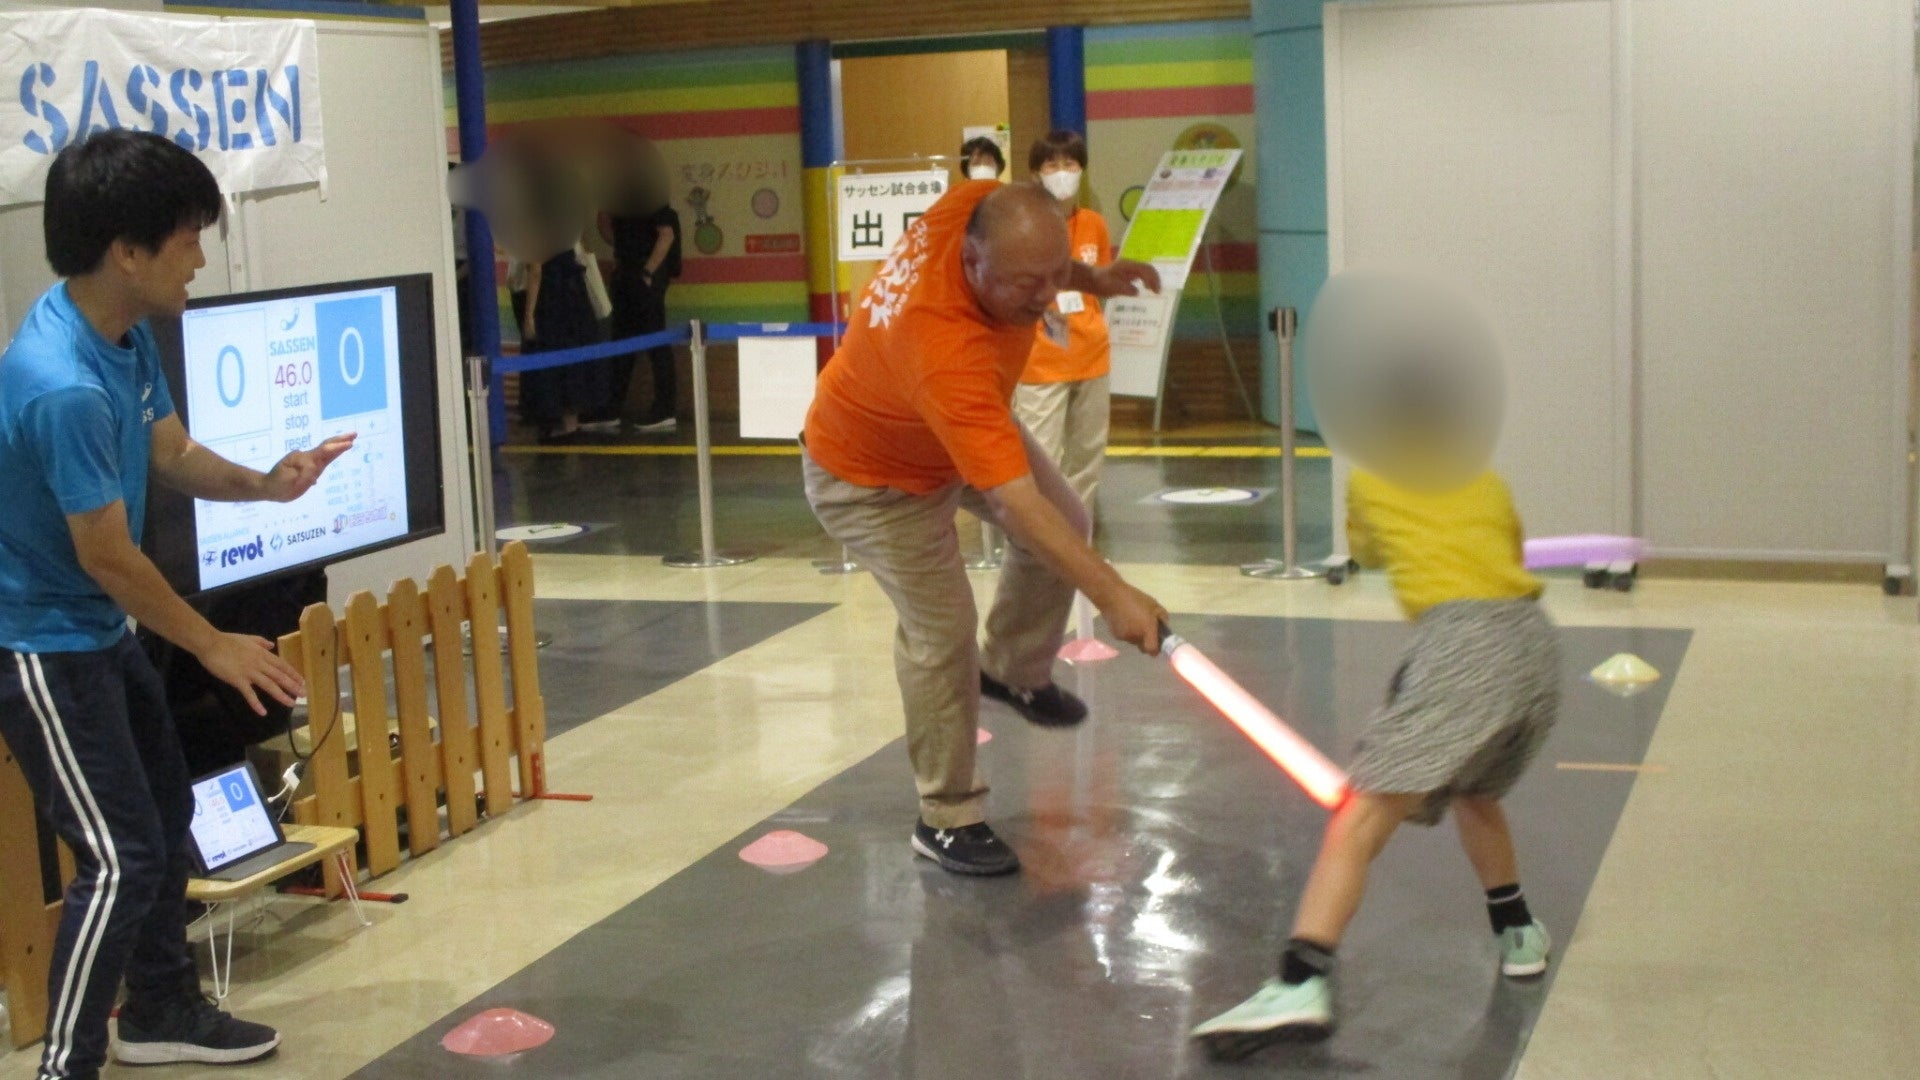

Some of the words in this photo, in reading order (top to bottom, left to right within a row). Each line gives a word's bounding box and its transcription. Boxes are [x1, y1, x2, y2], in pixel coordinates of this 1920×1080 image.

[19, 60, 301, 155] SASSEN
[844, 181, 942, 198] サッセン試合会場
[269, 336, 316, 356] SASSEN
[339, 326, 365, 386] 0
[216, 344, 245, 408] 0
[275, 360, 313, 388] 46.0
[283, 391, 309, 408] start
[285, 414, 310, 431] stop
[285, 434, 312, 451] reset
[287, 526, 327, 546] SATSUZEN
[230, 782, 243, 801] 0
